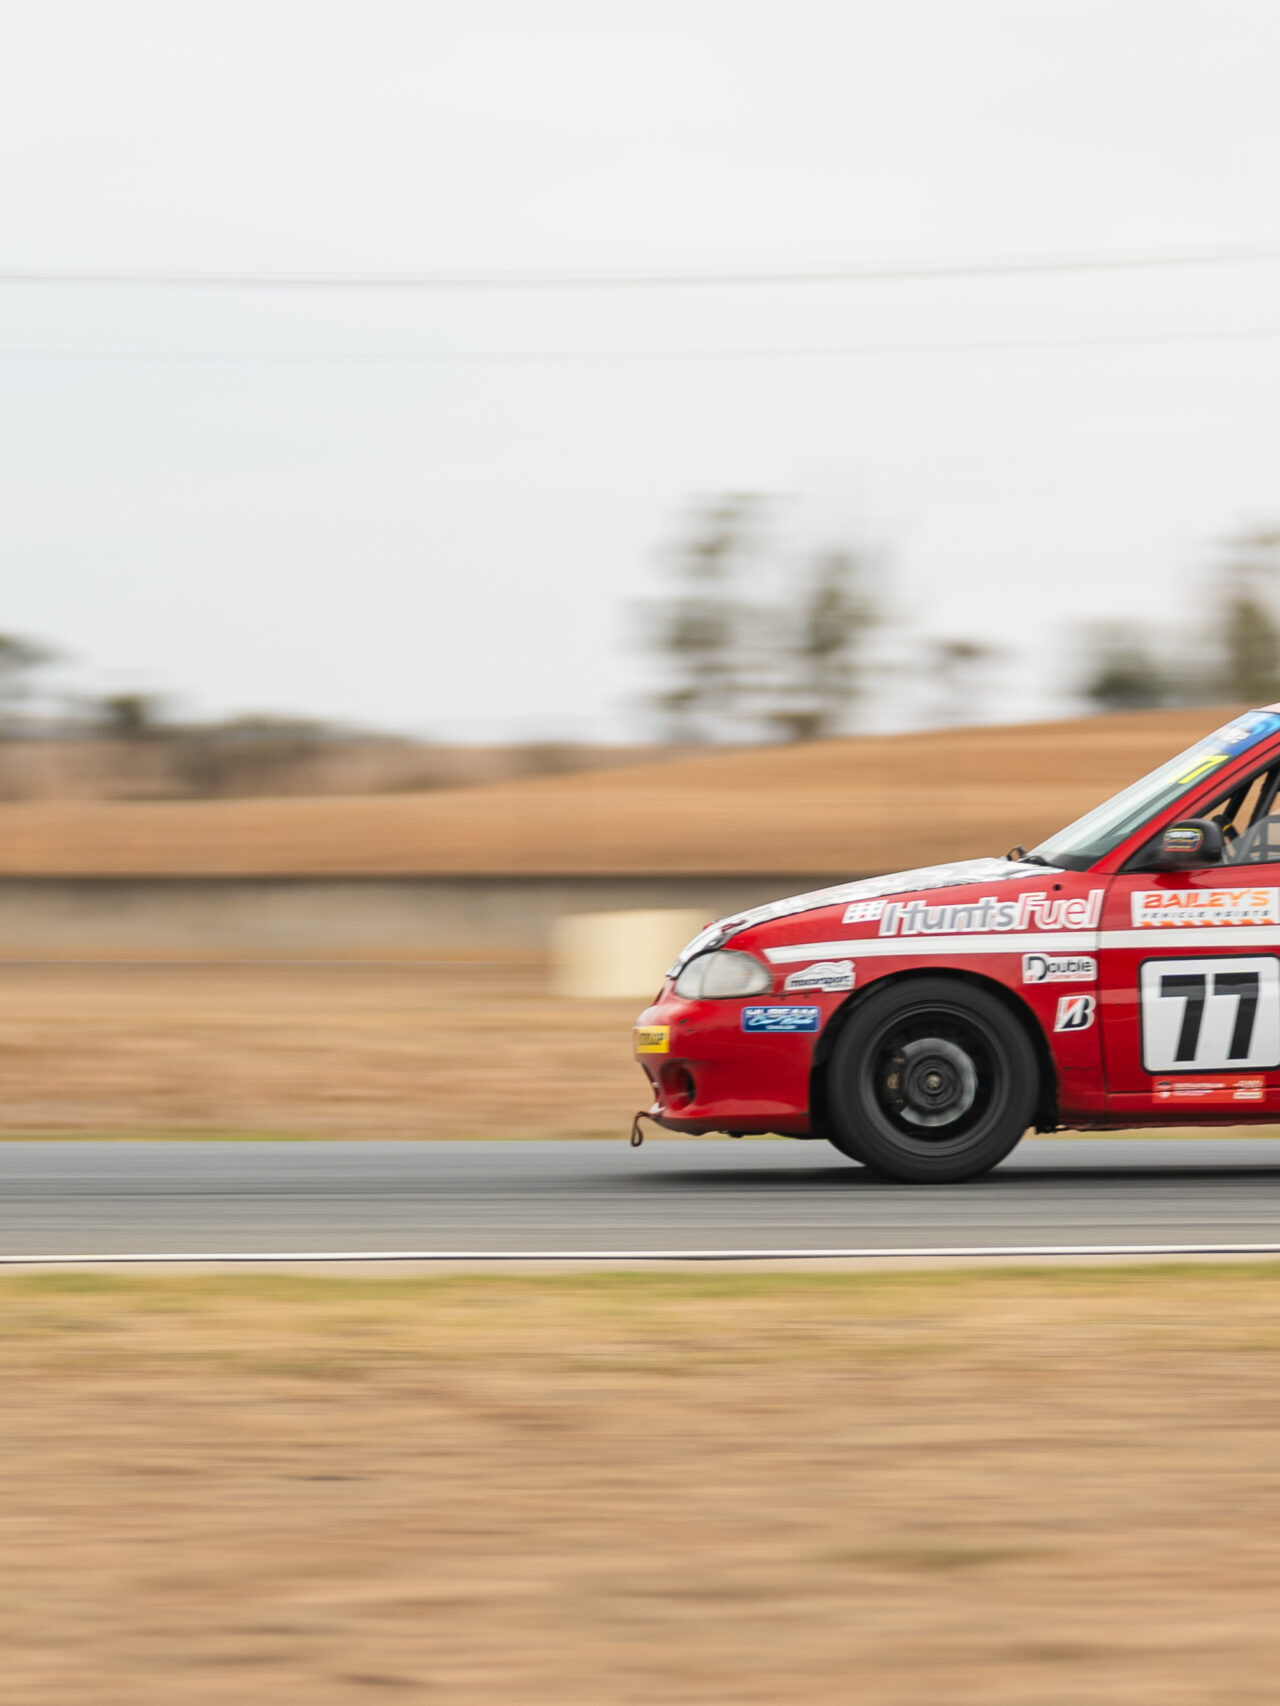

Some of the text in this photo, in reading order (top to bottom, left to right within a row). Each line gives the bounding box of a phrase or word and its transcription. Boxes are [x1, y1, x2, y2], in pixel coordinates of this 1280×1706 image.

[878, 889, 1106, 937] HuntsFuel
[1143, 888, 1271, 909] BAILEY'S
[1026, 955, 1094, 981] Double
[1159, 971, 1261, 1063] 77
